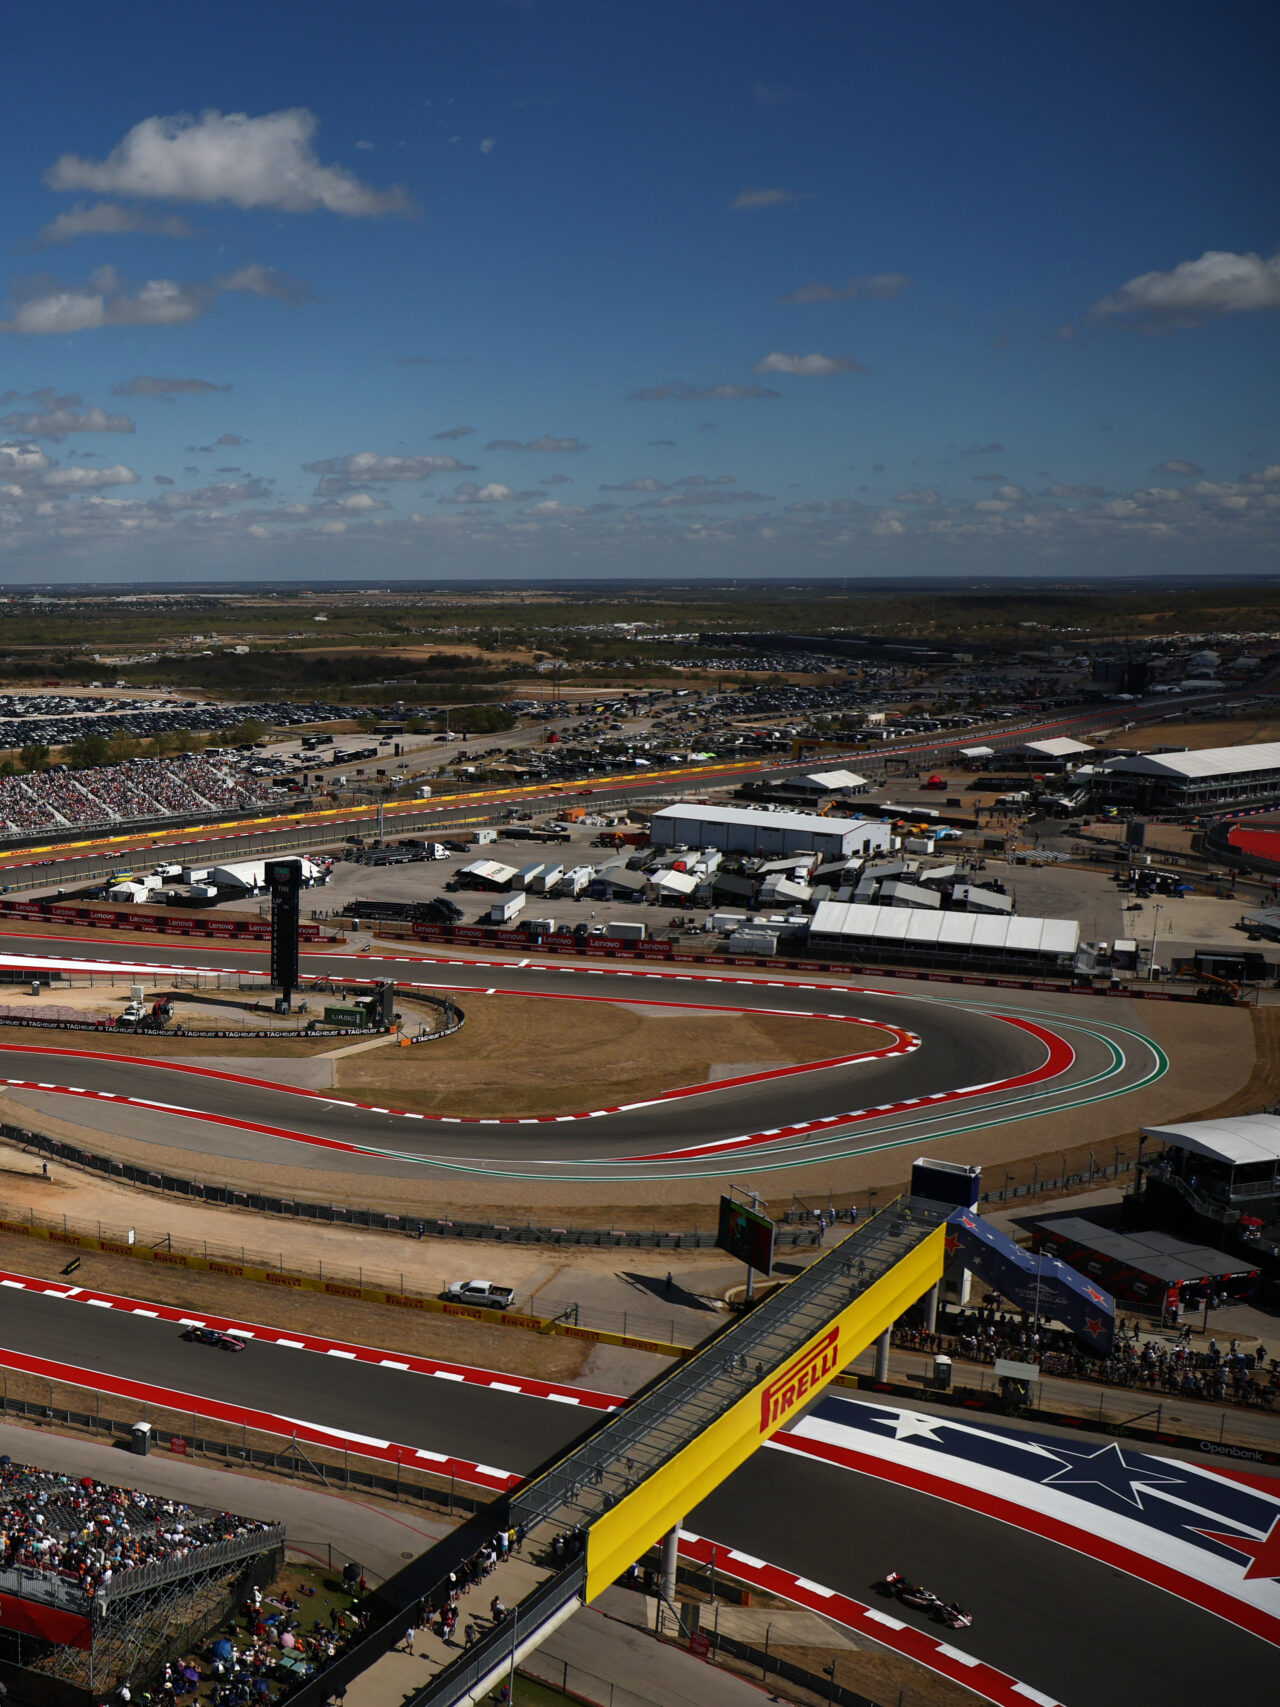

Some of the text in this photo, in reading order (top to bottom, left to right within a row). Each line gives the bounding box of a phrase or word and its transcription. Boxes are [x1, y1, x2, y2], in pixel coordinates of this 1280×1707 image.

[15, 903, 38, 911] Lenovo
[53, 907, 76, 916] Lenovo
[90, 912, 115, 920] Lenovo
[129, 916, 153, 924] Lenovo
[168, 919, 193, 927] Lenovo
[208, 921, 233, 930] Lenovo
[414, 925, 440, 934] Lenovo
[455, 929, 482, 937] Lenovo
[499, 931, 526, 941] Lenovo
[543, 936, 572, 945] Lenovo
[590, 939, 620, 948] Lenovo
[639, 942, 670, 951] Lenovo
[0, 1221, 29, 1235] PIRELLI
[49, 1231, 81, 1245] PIRELLI
[100, 1242, 132, 1255] PIRELLI
[154, 1252, 187, 1266] PIRELLI
[209, 1262, 243, 1276] PIRELLI
[266, 1273, 301, 1287] PIRELLI
[325, 1284, 361, 1298] PIRELLI
[386, 1294, 424, 1309] PIRELLI
[443, 1304, 482, 1319] PIRELLI
[501, 1315, 541, 1330] PIRELLI
[565, 1326, 600, 1341] PIRELLI
[622, 1337, 658, 1352] PIRELLI
[760, 1325, 840, 1434] PIRELLI
[1200, 1441, 1263, 1461] Openbank
